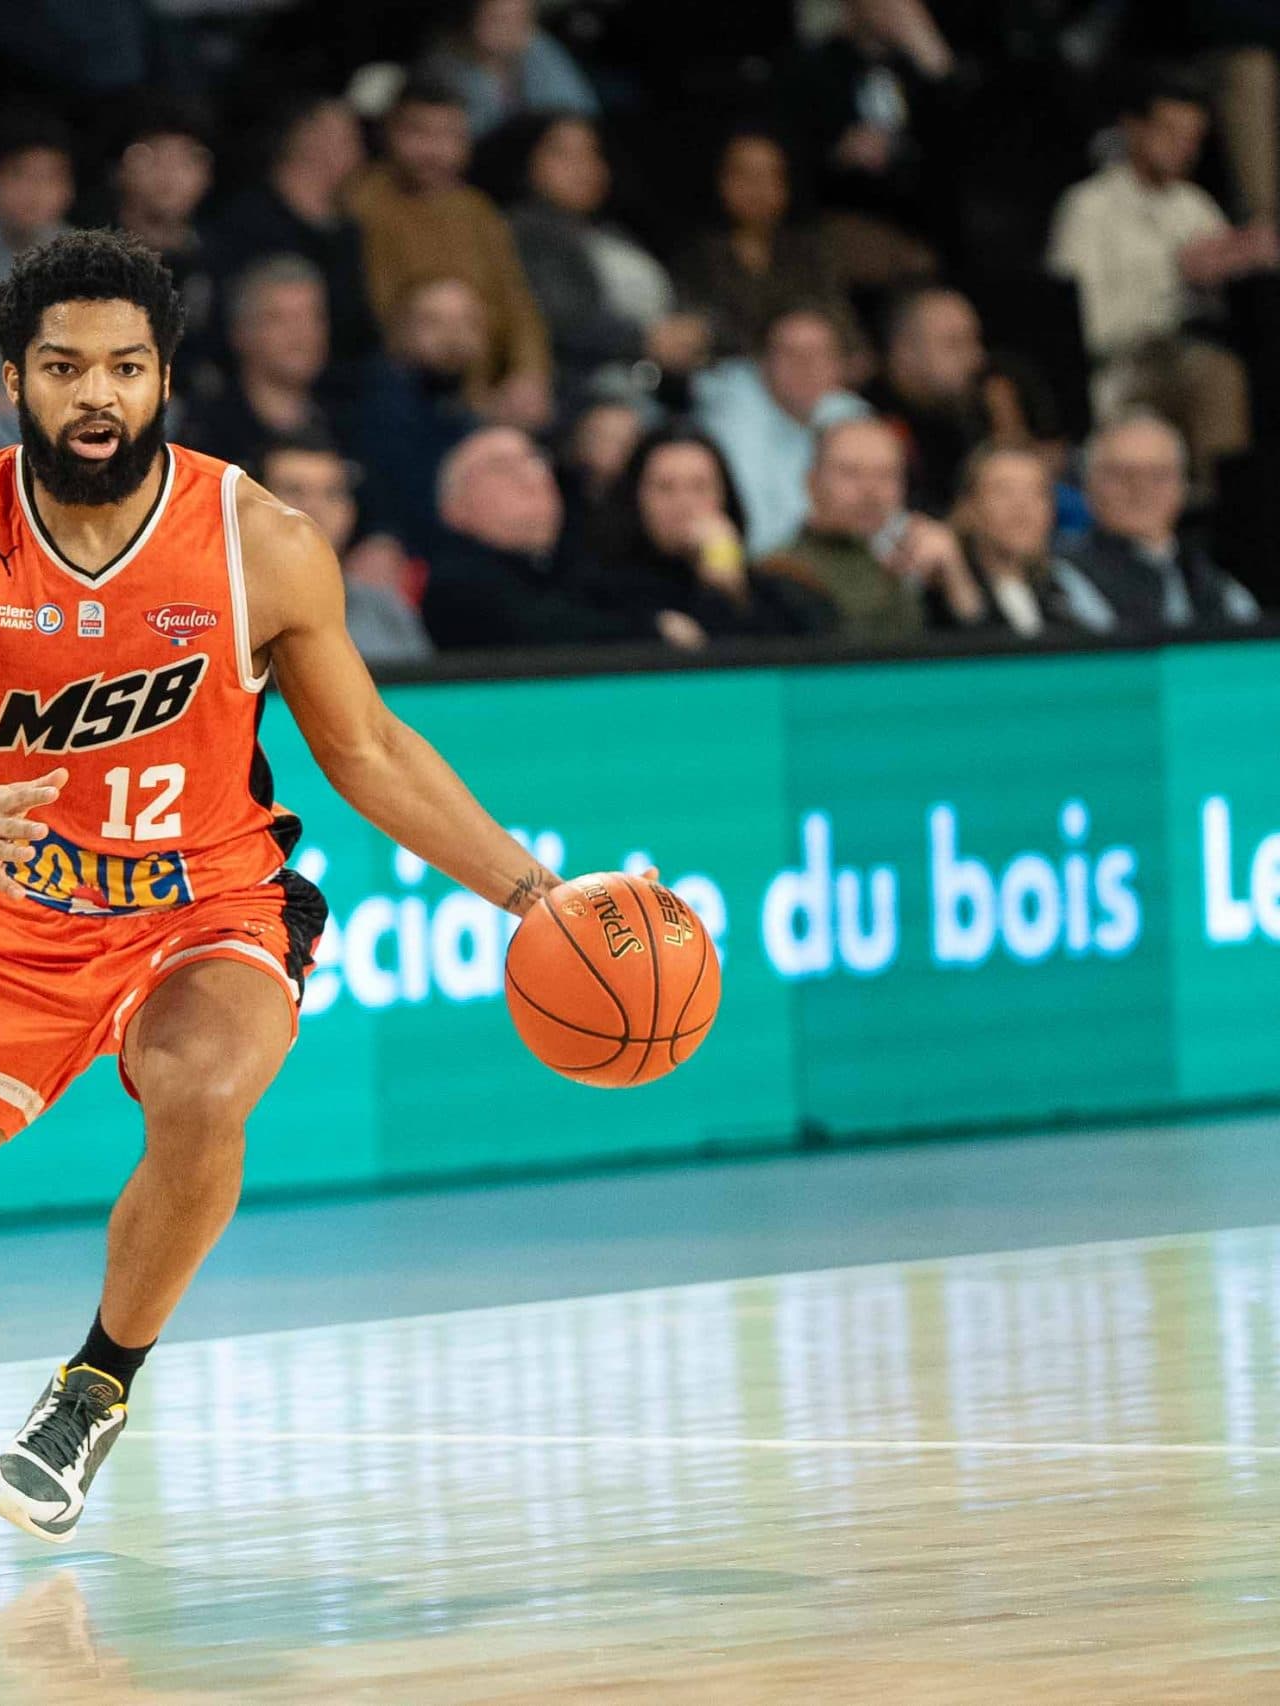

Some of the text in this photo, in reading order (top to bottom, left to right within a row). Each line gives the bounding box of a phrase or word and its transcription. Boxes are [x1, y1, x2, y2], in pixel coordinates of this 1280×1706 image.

[0, 617, 33, 630] MANS
[156, 608, 217, 631] Gaulois
[101, 763, 186, 841] 12
[760, 808, 899, 980] du
[928, 800, 1141, 966] bois
